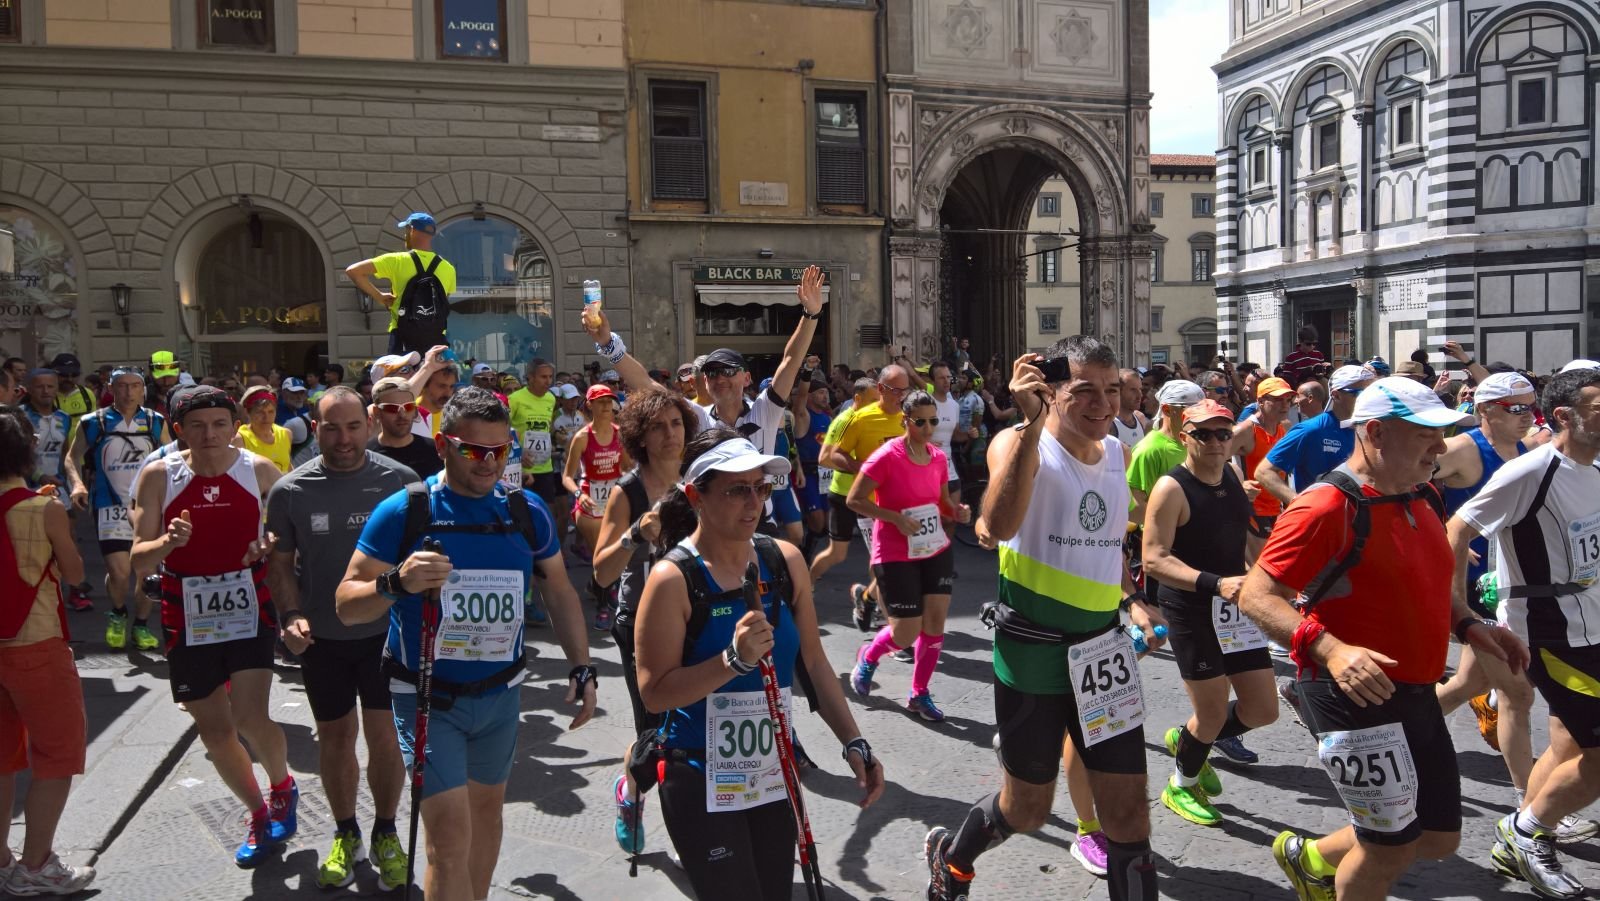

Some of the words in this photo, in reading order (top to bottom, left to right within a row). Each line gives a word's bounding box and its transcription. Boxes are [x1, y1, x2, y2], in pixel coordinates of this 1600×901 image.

[211, 8, 263, 19] A.POGGI
[447, 21, 495, 31] A.POGGI
[708, 267, 752, 280] BLACK
[756, 268, 782, 280] BAR
[528, 440, 547, 452] 761
[104, 507, 129, 521] 132
[1048, 534, 1083, 547] equipe
[1084, 537, 1096, 547] de
[193, 587, 250, 615] 1463
[452, 592, 515, 624] 3008
[712, 606, 732, 617] asics
[1081, 653, 1131, 696] 453
[731, 697, 754, 707] Banca
[755, 695, 761, 706] di
[718, 717, 774, 759] 300
[1361, 730, 1396, 741] Romagna
[716, 761, 737, 770] LAURA
[1330, 750, 1402, 788] 2251
